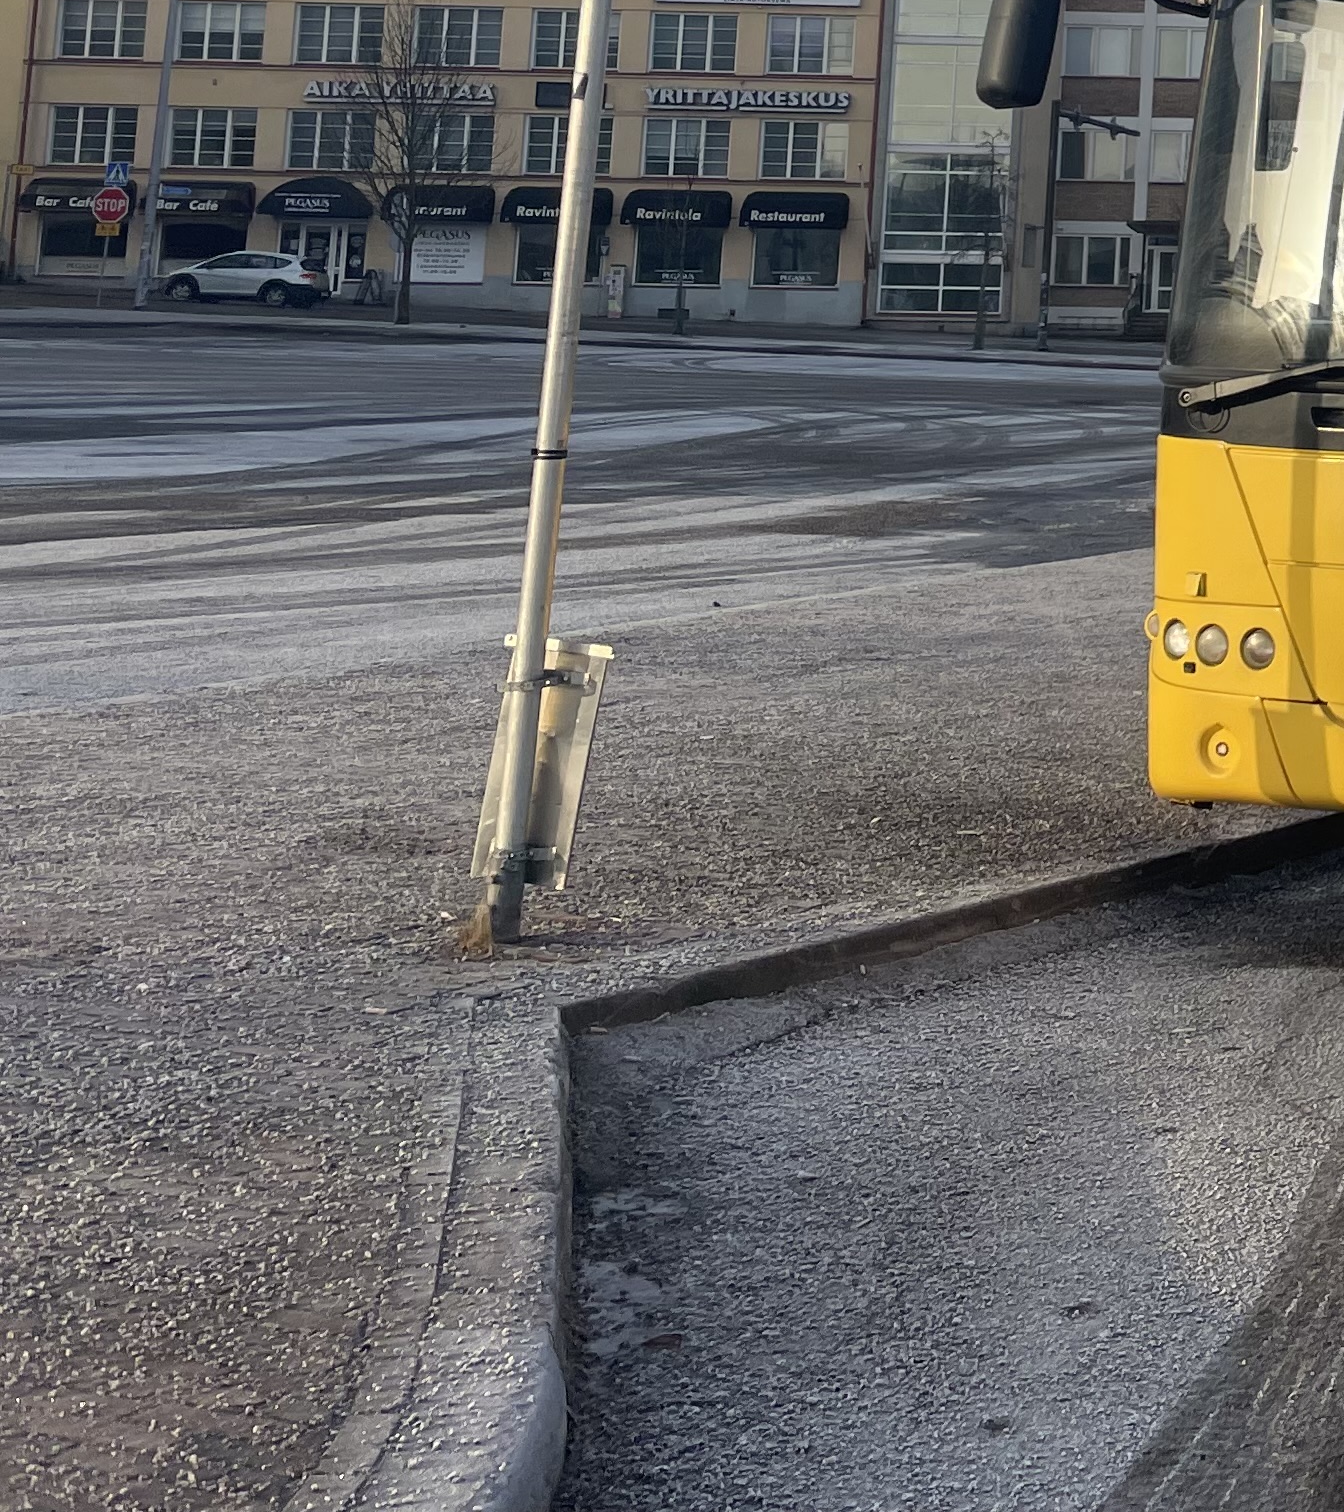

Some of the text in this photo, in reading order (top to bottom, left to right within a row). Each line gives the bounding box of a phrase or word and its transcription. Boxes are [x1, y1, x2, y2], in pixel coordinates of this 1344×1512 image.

[302, 80, 371, 98] AIKA
[645, 87, 850, 110] YRITTÄJÄKESKUS
[35, 196, 61, 208] Bar
[95, 198, 126, 212] STOP
[156, 199, 219, 211] Bar Café
[516, 205, 561, 217] Ravint
[636, 207, 702, 221] Ravintola
[750, 210, 825, 223] Restaurant
